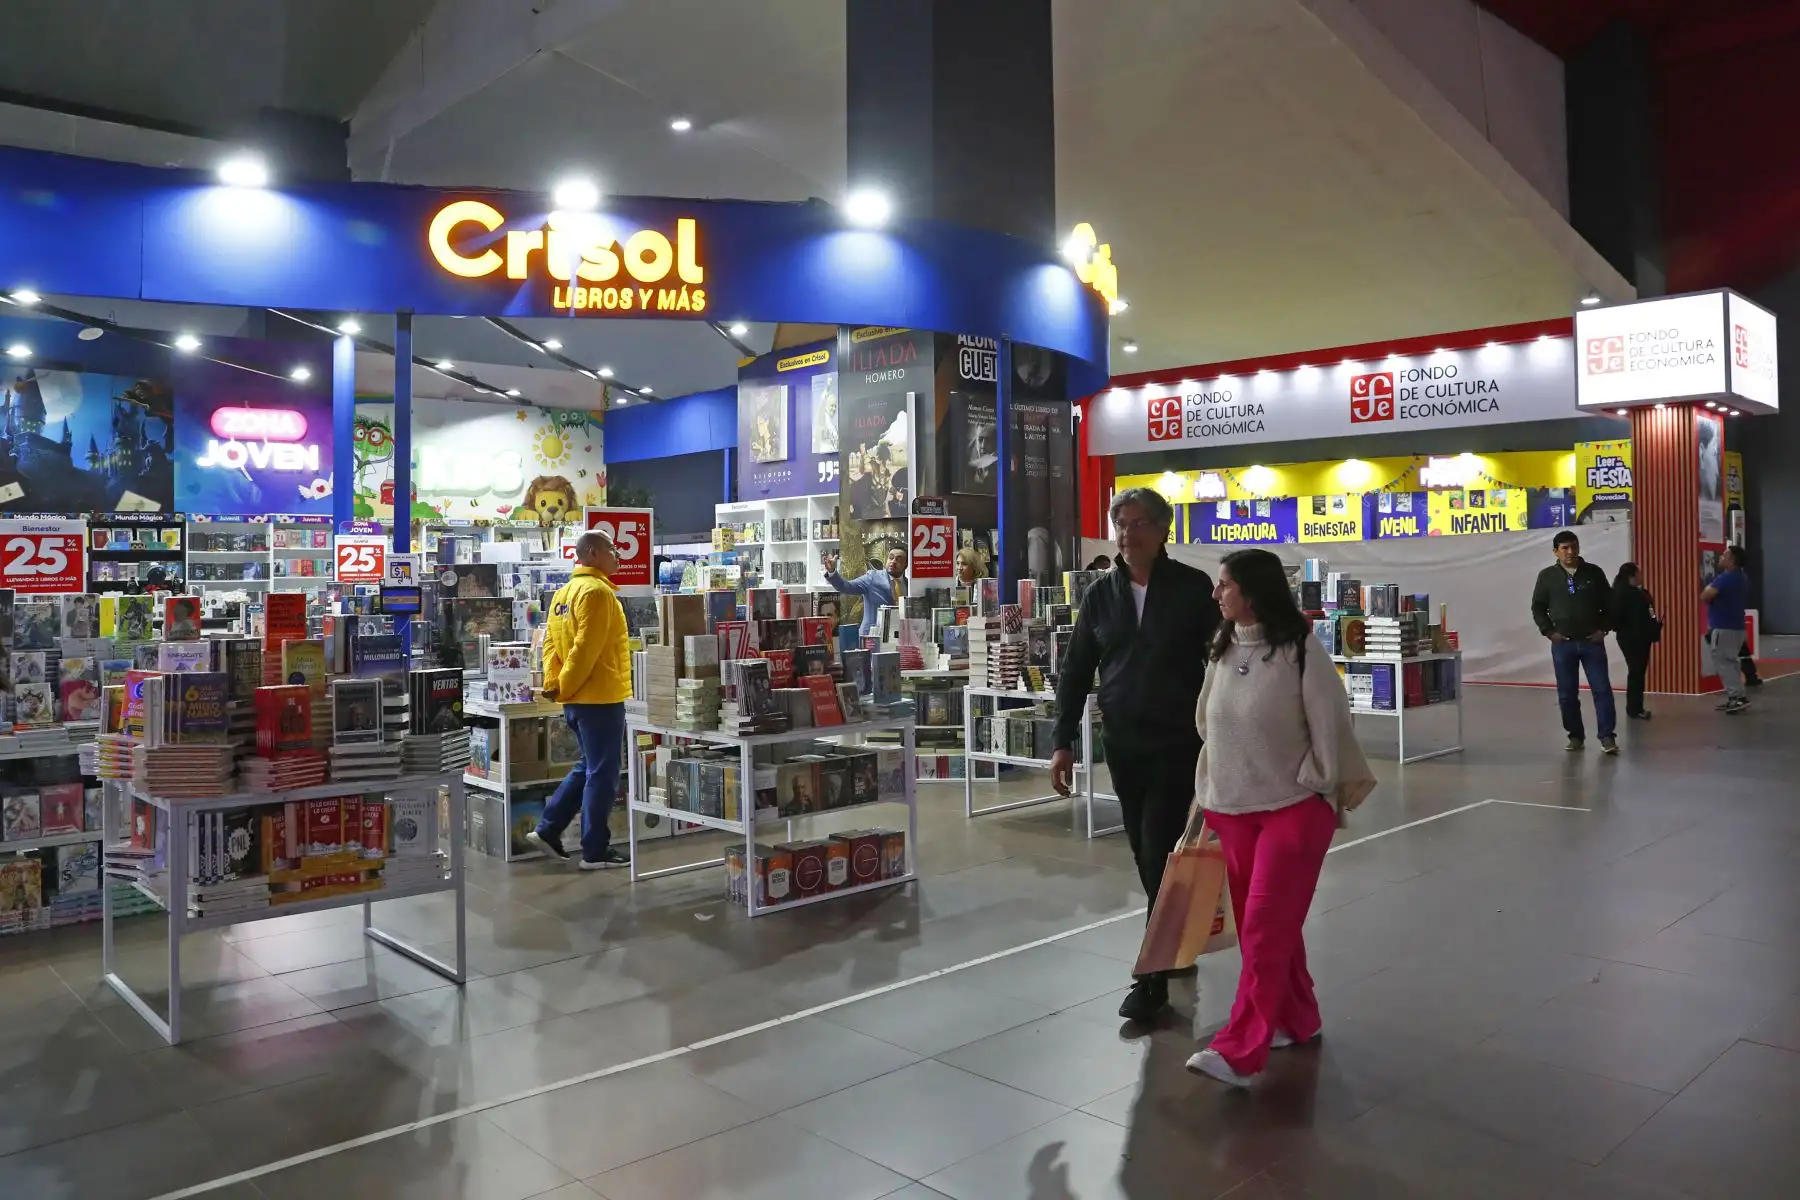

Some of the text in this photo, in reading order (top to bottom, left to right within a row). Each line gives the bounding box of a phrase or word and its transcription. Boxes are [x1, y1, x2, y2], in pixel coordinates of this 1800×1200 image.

[429, 201, 703, 284] Crisol
[554, 284, 706, 311] LIBROS Y MÁS
[1630, 328, 1679, 344] FONDO
[853, 340, 917, 372] ILIADA
[1630, 337, 1715, 358] DE CULTURA
[779, 358, 803, 369] Exclusivos
[812, 351, 826, 362] Crisol
[959, 347, 998, 382] CUET
[865, 368, 905, 384] HOMERO
[1400, 365, 1457, 383] FONDO
[1187, 391, 1232, 406] FONDO
[1401, 379, 1499, 401] DE CULTURA
[1187, 404, 1265, 422] DE CULTURA
[1401, 398, 1499, 420] ECONÓMICA
[223, 412, 298, 434] ZONA
[1187, 420, 1265, 438] ECONÓMICA
[196, 439, 319, 471] JOVEN
[1596, 455, 1616, 467] Leer
[1587, 466, 1632, 487] FIESTA
[1595, 493, 1626, 501] Novedad
[139, 513, 164, 522] Mágico
[1451, 512, 1509, 534] INFANTIL
[22, 525, 61, 533] Bienestar
[1212, 522, 1278, 542] LITERATURA
[1304, 520, 1356, 538] BIENESTAR
[913, 525, 947, 558] 25
[4, 537, 67, 576] 25
[340, 547, 376, 572] 25
[363, 652, 400, 661] MILLONARIO
[770, 658, 790, 672] ABC
[432, 678, 459, 690] VENTAS
[231, 835, 248, 853] PNL
